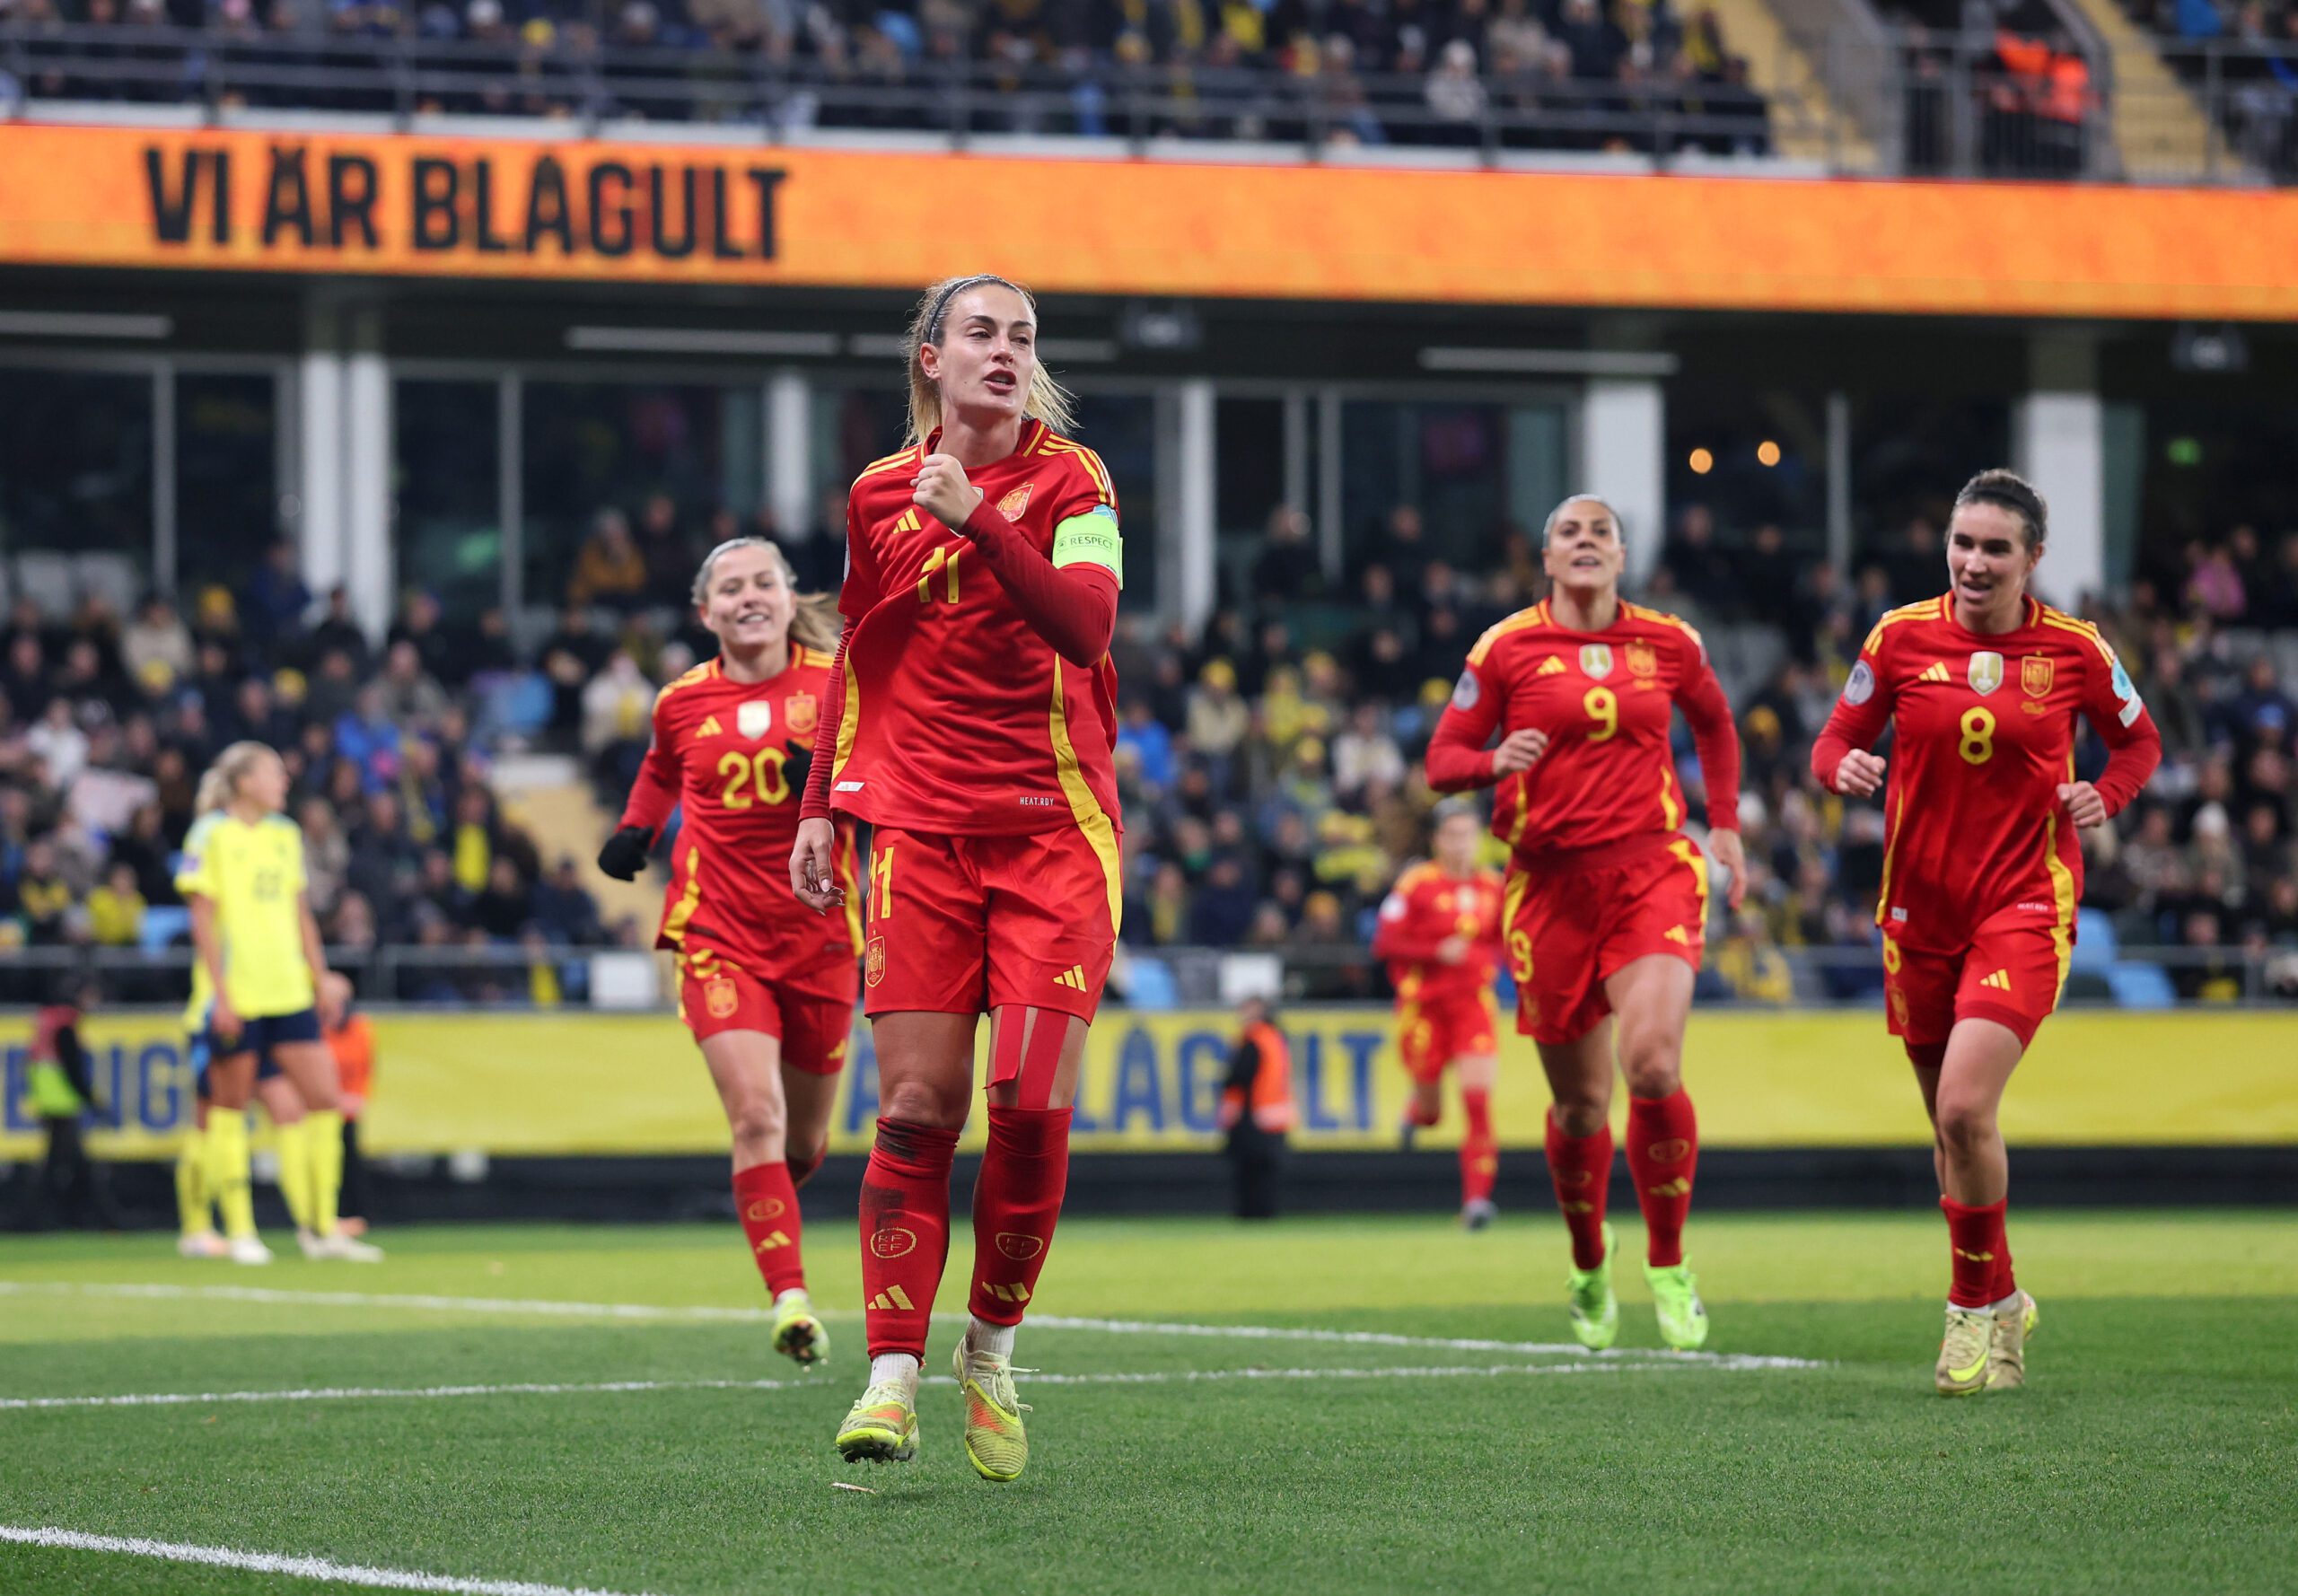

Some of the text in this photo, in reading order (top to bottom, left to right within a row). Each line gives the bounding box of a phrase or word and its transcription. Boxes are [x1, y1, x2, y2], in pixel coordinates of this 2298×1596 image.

[143, 144, 790, 262] VI ÄR BLÅGULT
[1070, 536, 1113, 551] RESPECT
[917, 547, 961, 604] 11
[1583, 686, 1618, 741] 9
[1959, 706, 1996, 766] 8
[718, 746, 790, 809] 20
[1020, 796, 1055, 807] HEAT.RDY
[868, 846, 895, 924] 11
[1509, 929, 1535, 984] 9
